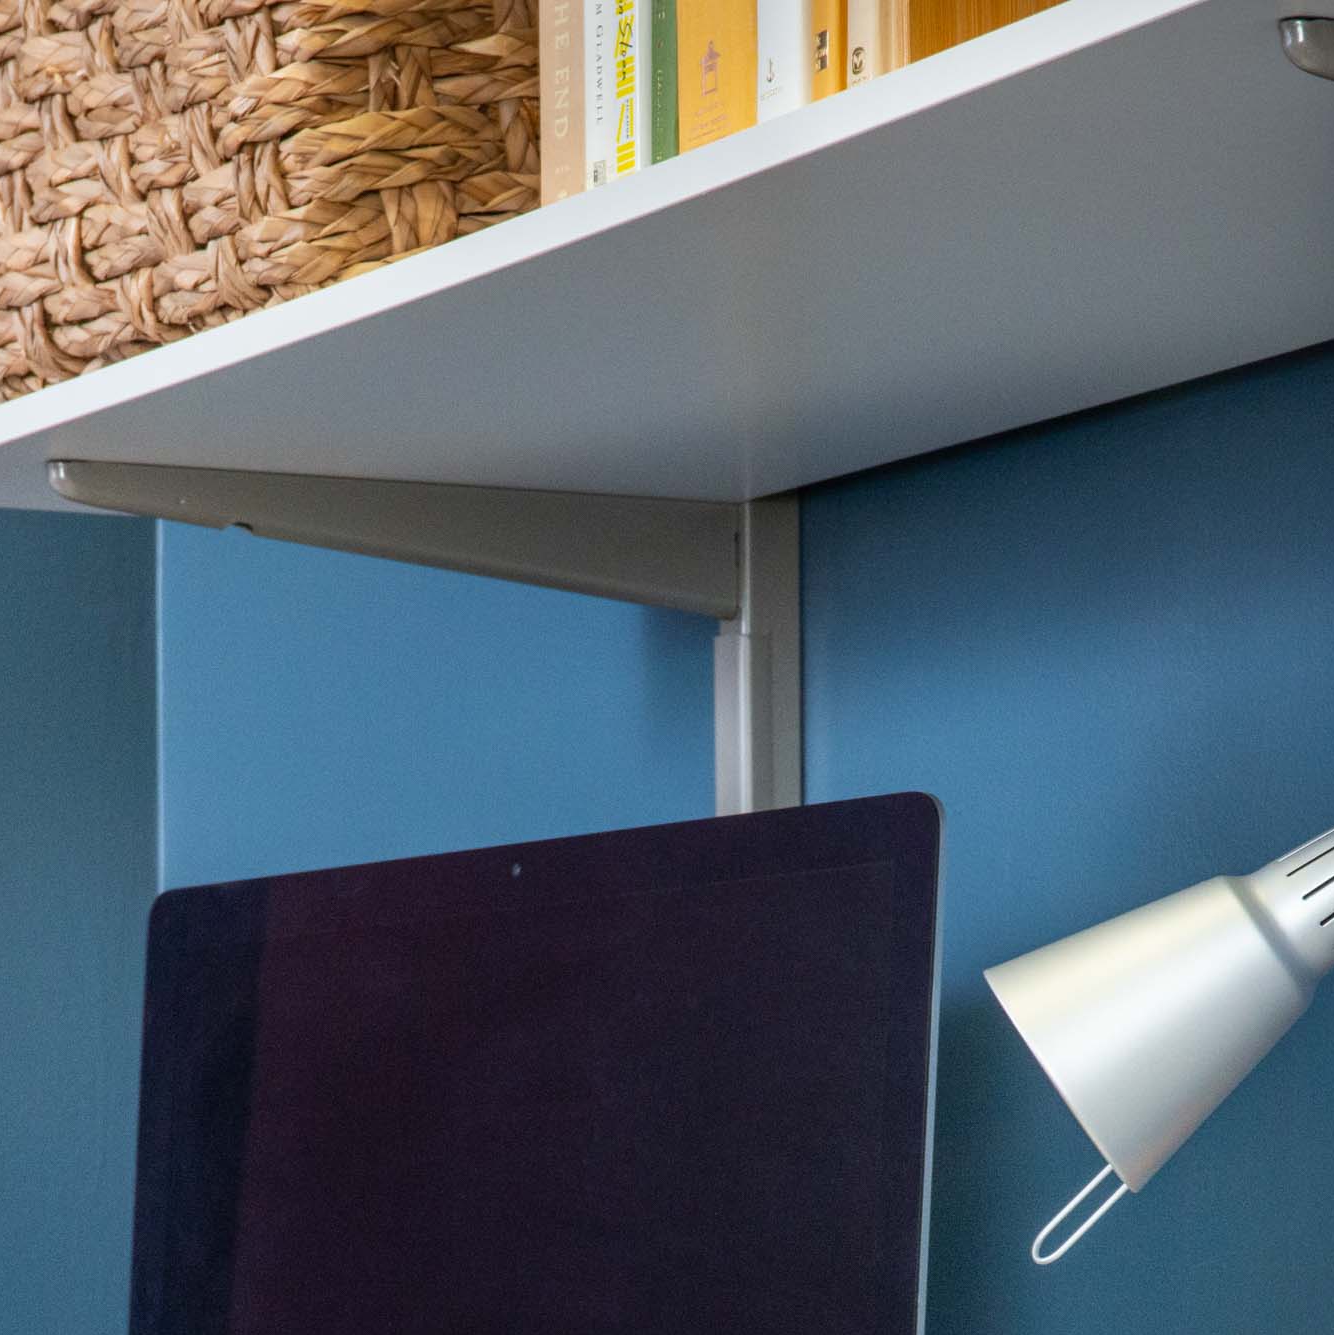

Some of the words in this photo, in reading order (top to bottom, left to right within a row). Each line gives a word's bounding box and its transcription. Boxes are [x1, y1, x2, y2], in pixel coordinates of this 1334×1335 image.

[596, 24, 604, 122] GLADWELL
[618, 20, 633, 81] Sloan
[554, 65, 572, 138] END
